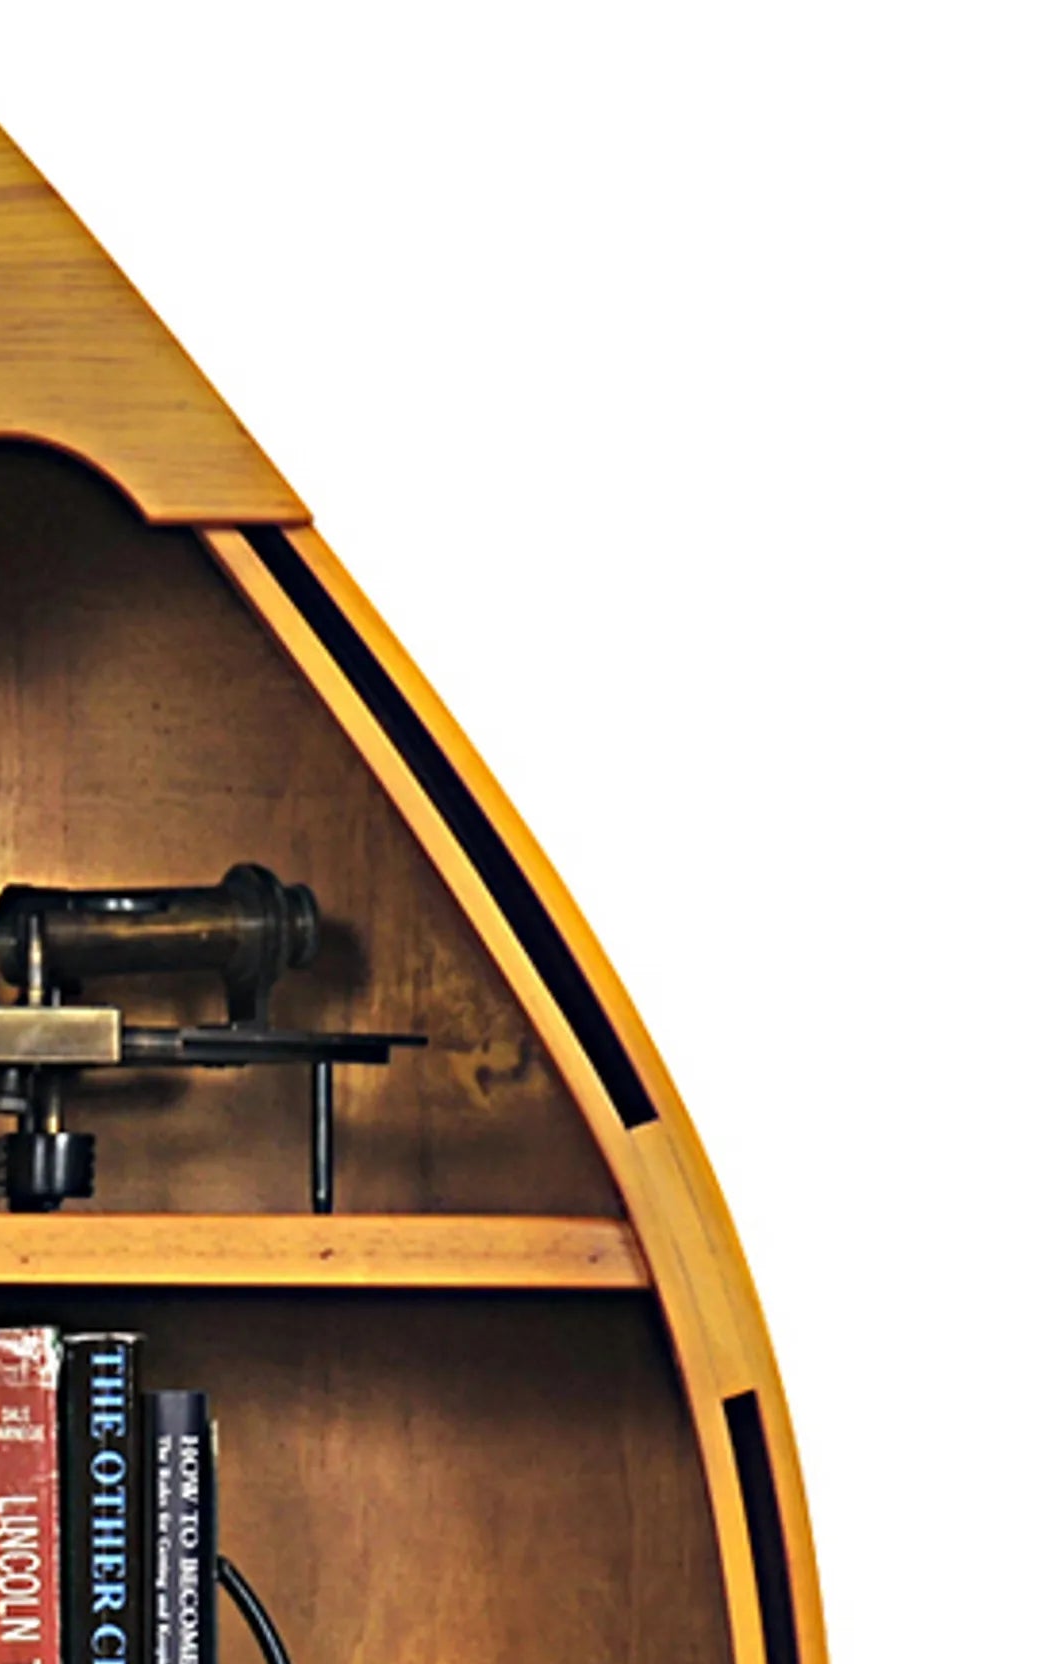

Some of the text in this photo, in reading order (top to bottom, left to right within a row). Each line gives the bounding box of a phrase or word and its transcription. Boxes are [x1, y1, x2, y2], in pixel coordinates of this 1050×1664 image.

[91, 1347, 127, 1439] THE
[178, 1434, 200, 1504] HOW
[91, 1449, 127, 1613] OTHER
[178, 1511, 200, 1550] TO
